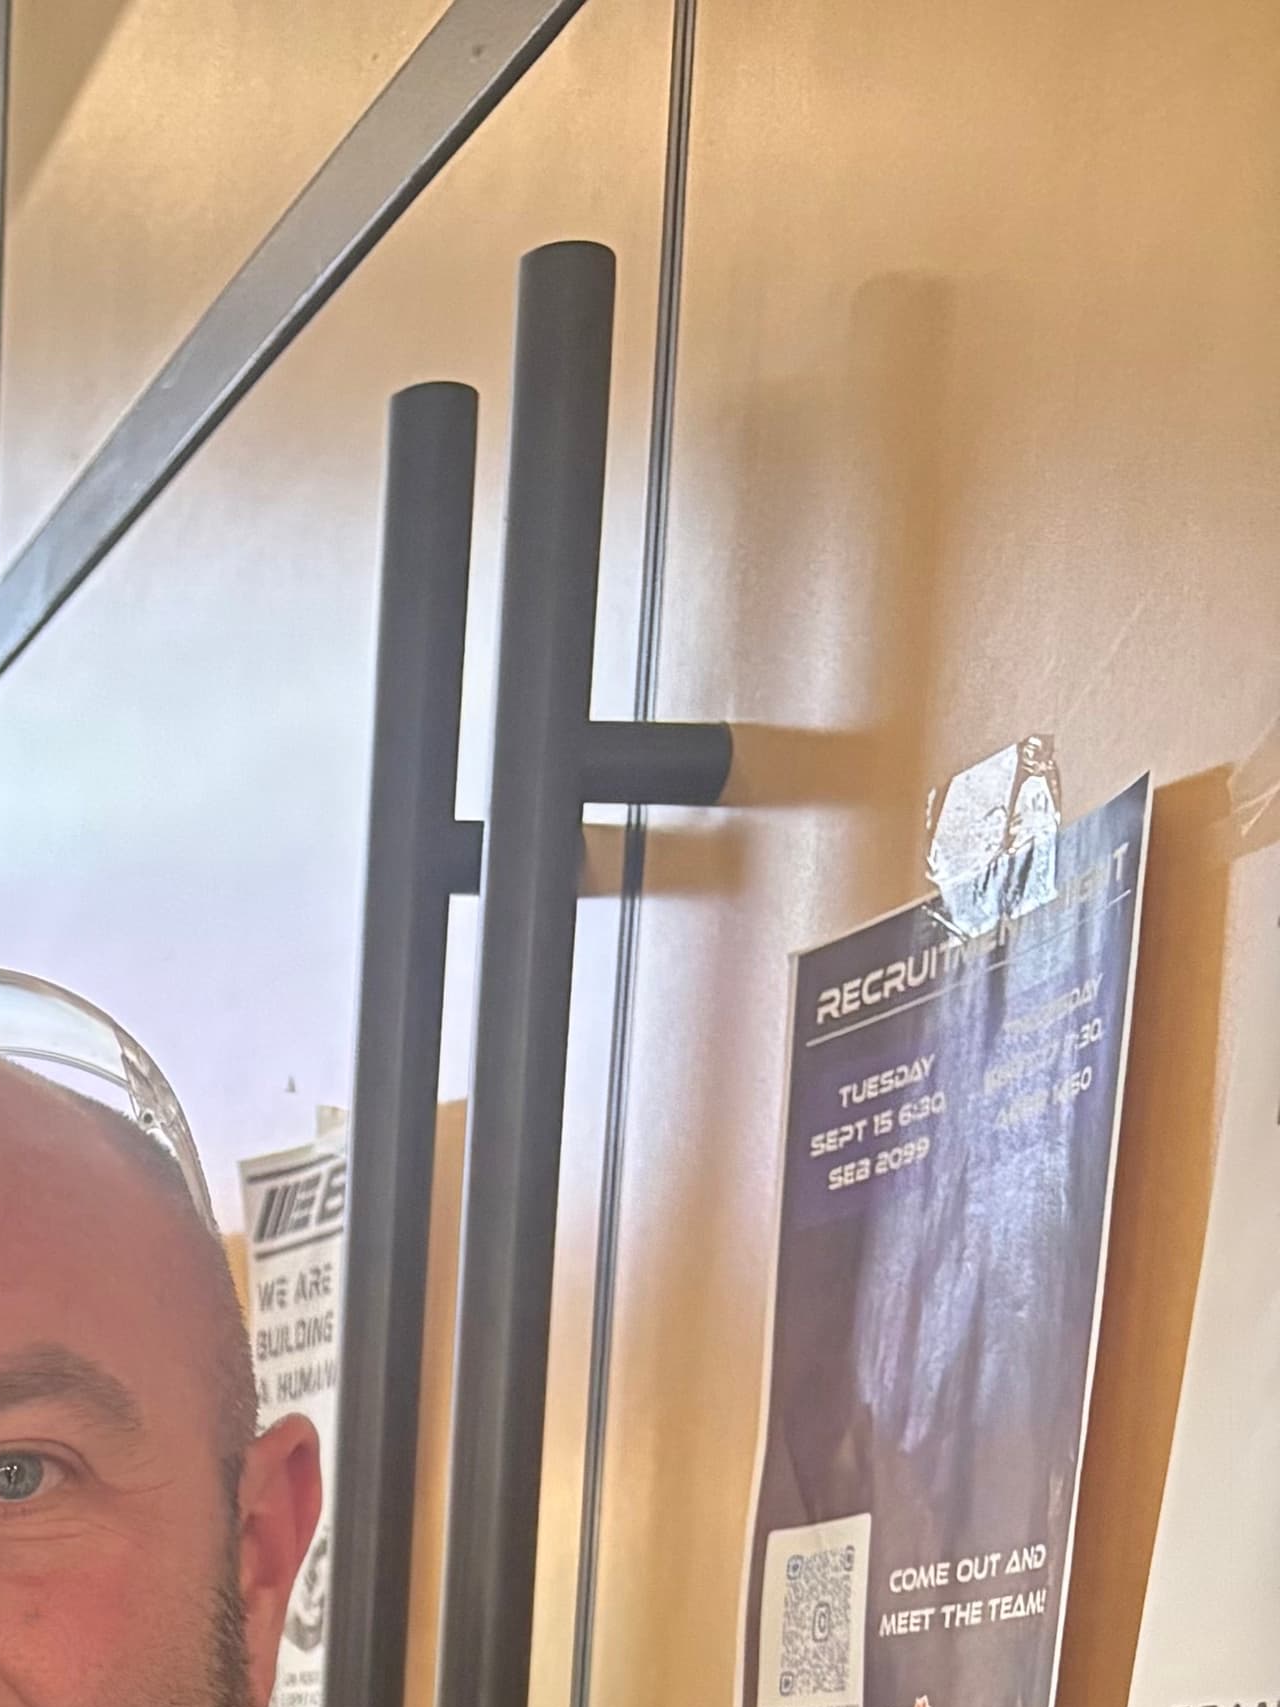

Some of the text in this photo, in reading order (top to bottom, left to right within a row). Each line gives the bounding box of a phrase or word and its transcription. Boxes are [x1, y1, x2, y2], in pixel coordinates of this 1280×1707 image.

[839, 1054, 936, 1108] TUESDAY
[810, 1091, 946, 1156] SEPT 15 6:30
[827, 1136, 930, 1190] SEB 2099
[256, 1263, 332, 1312] WE ARE
[255, 1312, 333, 1361] BUILDING
[889, 1544, 1047, 1593] COME OUT AND
[879, 1589, 1047, 1638] MEET THE TEAM!
